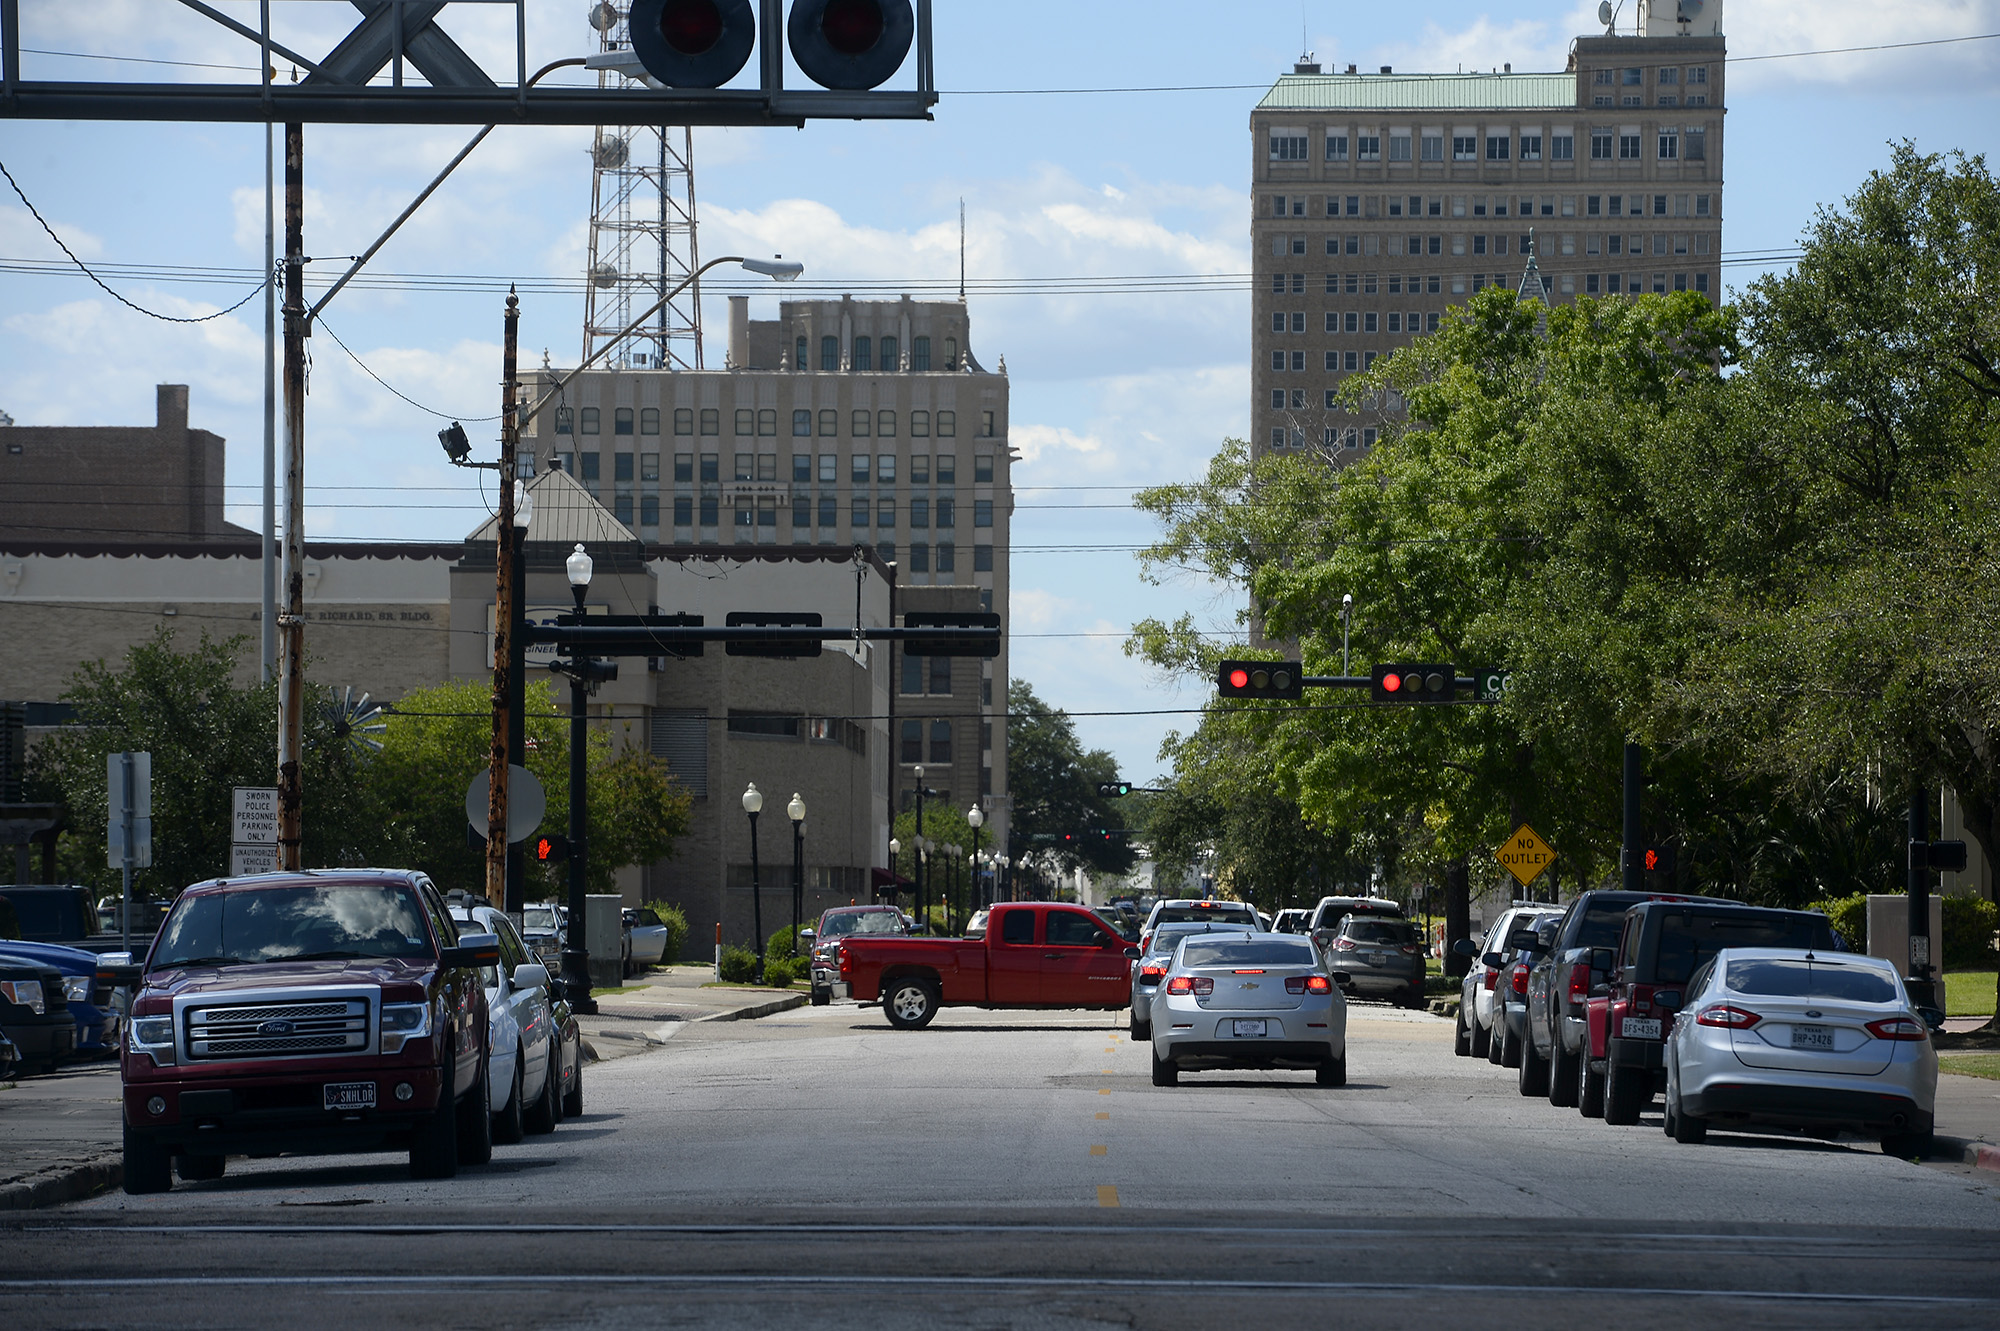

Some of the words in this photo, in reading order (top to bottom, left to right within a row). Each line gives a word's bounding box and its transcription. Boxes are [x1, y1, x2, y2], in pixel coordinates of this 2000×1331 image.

[319, 612, 376, 622] RICHARD,
[378, 612, 397, 621] SR.
[401, 612, 433, 621] BLDG.
[246, 792, 271, 800] SWORN
[245, 802, 270, 810] POLICE
[237, 812, 277, 820] PERSONNEL
[242, 822, 272, 830] PARKING
[247, 832, 266, 840] ONLY
[1517, 838, 1534, 849] NO
[242, 858, 271, 866] VEHICLES
[1502, 853, 1548, 864] OUTLET
[340, 1090, 374, 1102] SNHLDR
